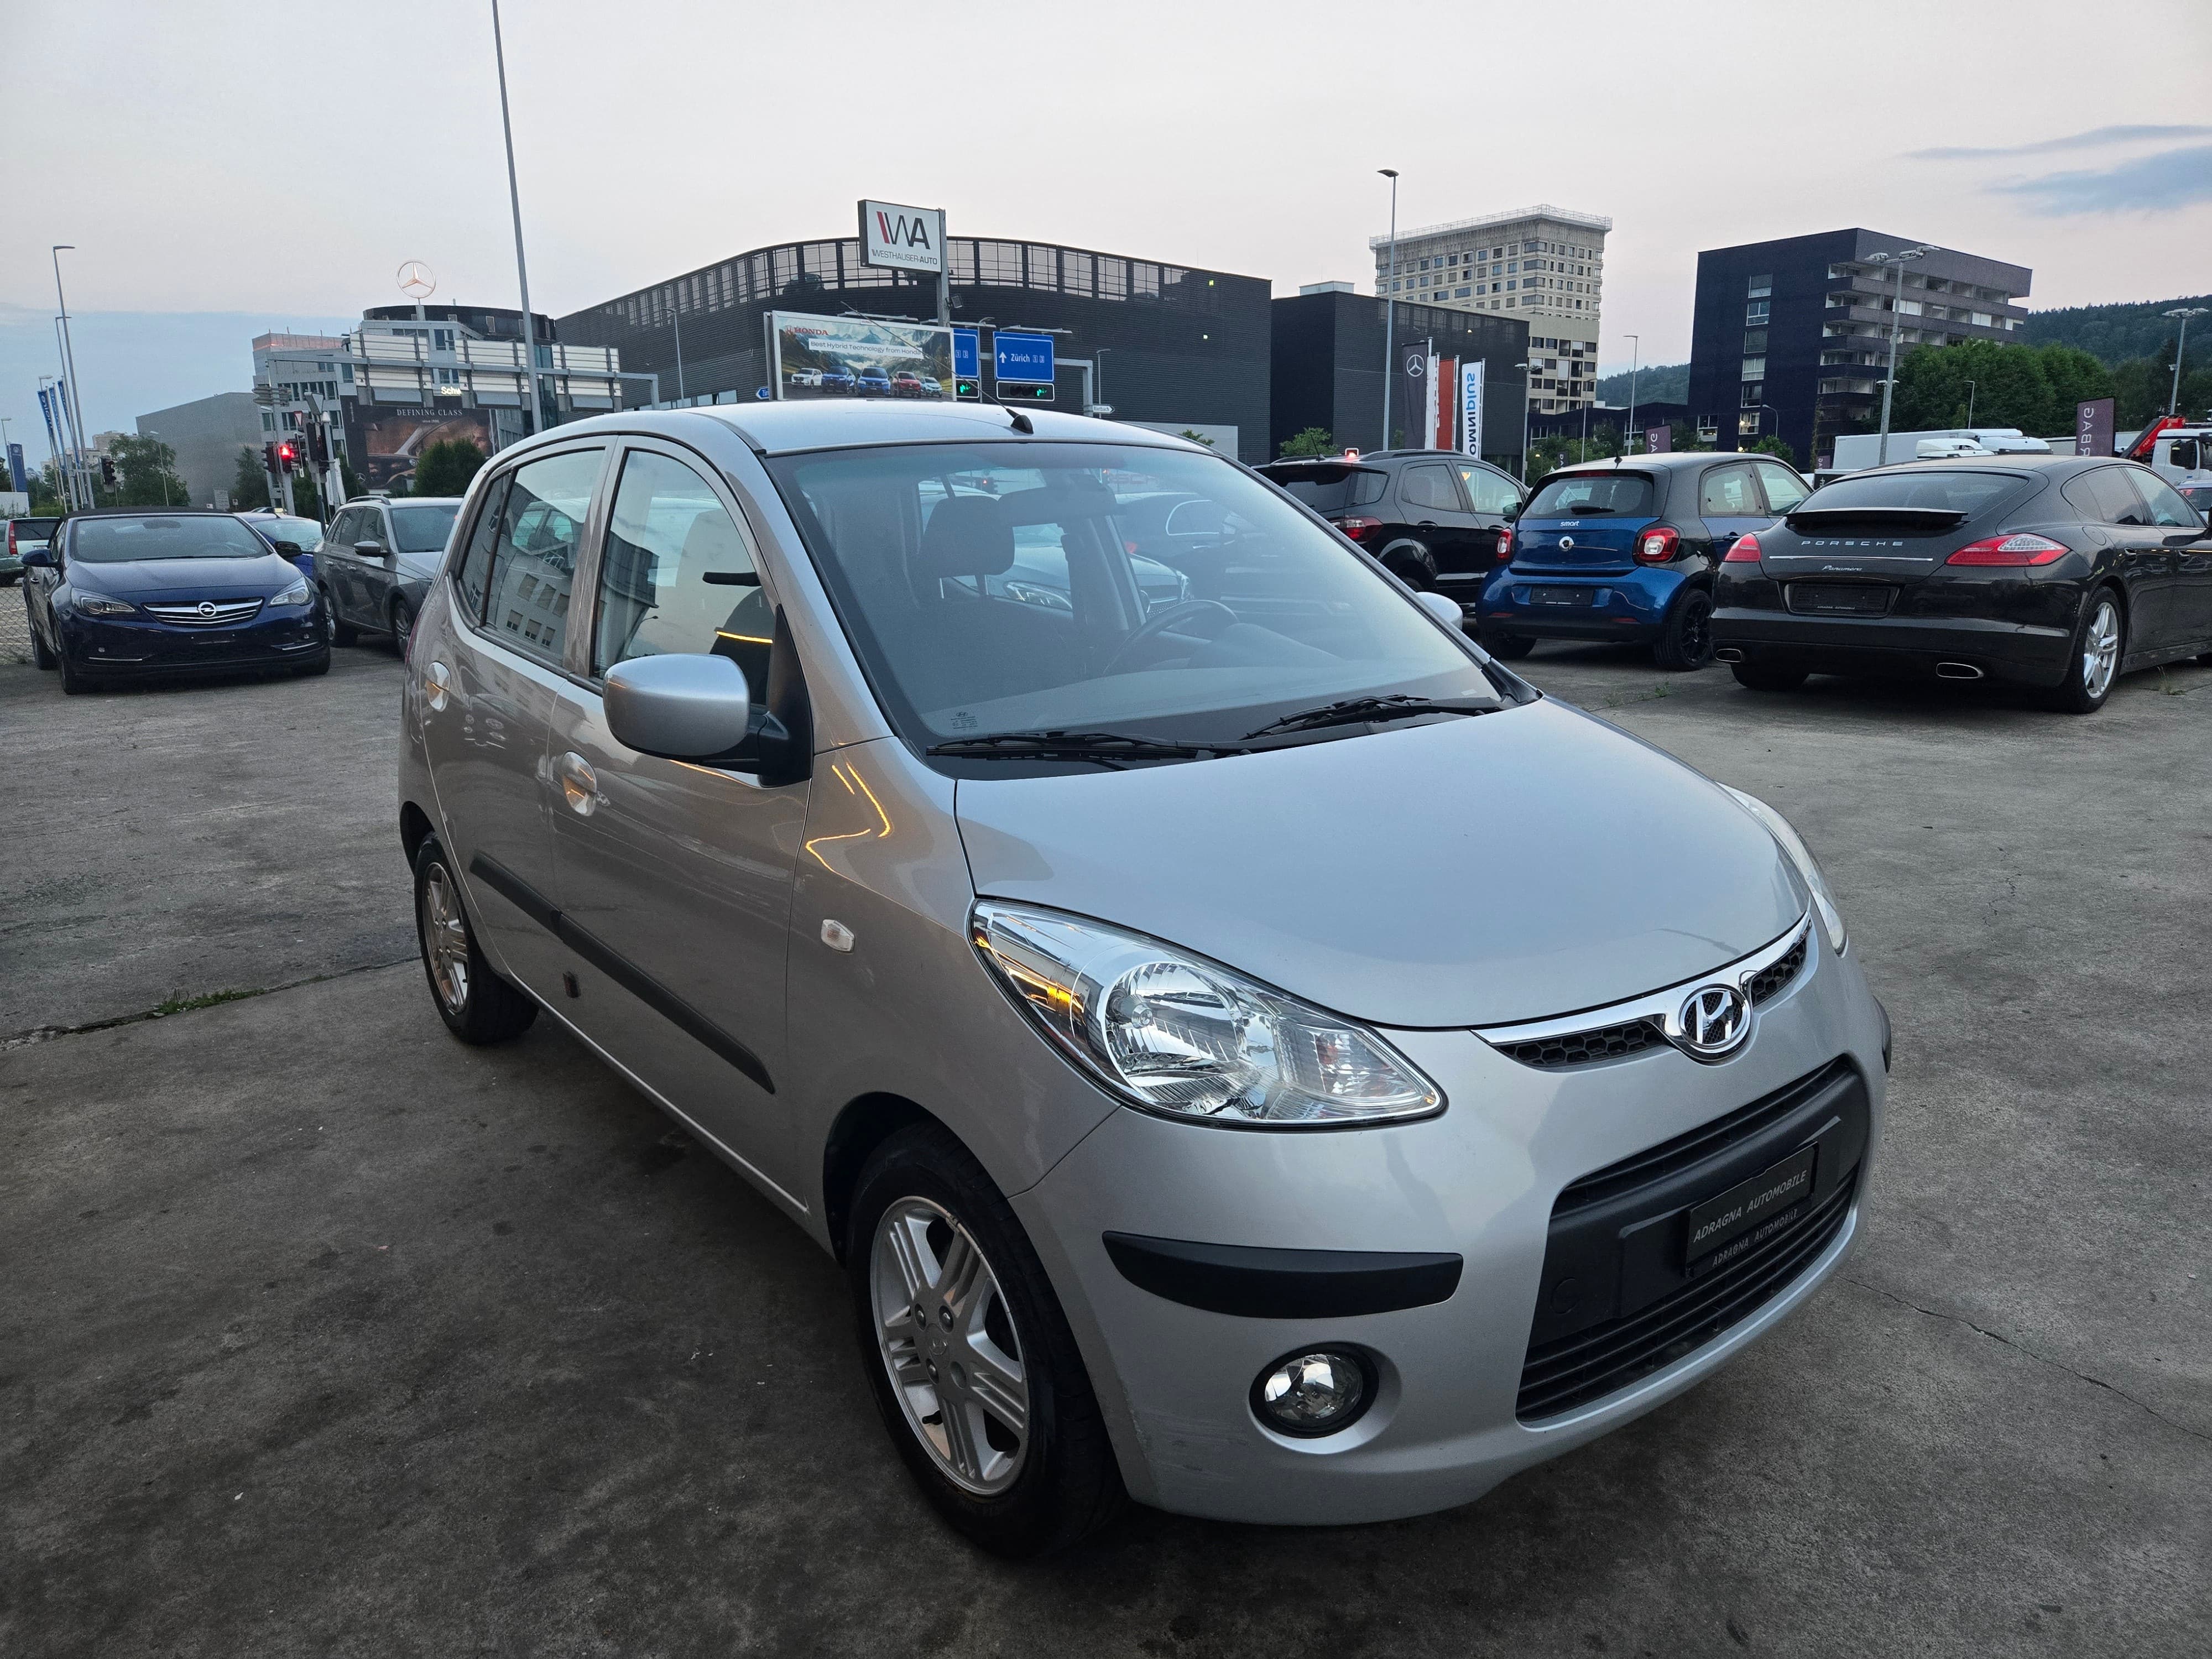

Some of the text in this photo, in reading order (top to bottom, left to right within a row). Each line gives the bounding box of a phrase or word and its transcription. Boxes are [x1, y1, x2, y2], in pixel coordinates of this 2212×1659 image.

[872, 249, 937, 265] WESTHAUSER-AUTO
[793, 327, 828, 336] HONDA
[827, 343, 848, 351] Hybrid
[849, 344, 885, 354] Technology
[1011, 353, 1030, 362] Zürich
[1693, 1170, 1807, 1244] ADRAGNA AUTOMOBILE
[1712, 1208, 1798, 1268] ADRAGNA AUTOMOBILE
